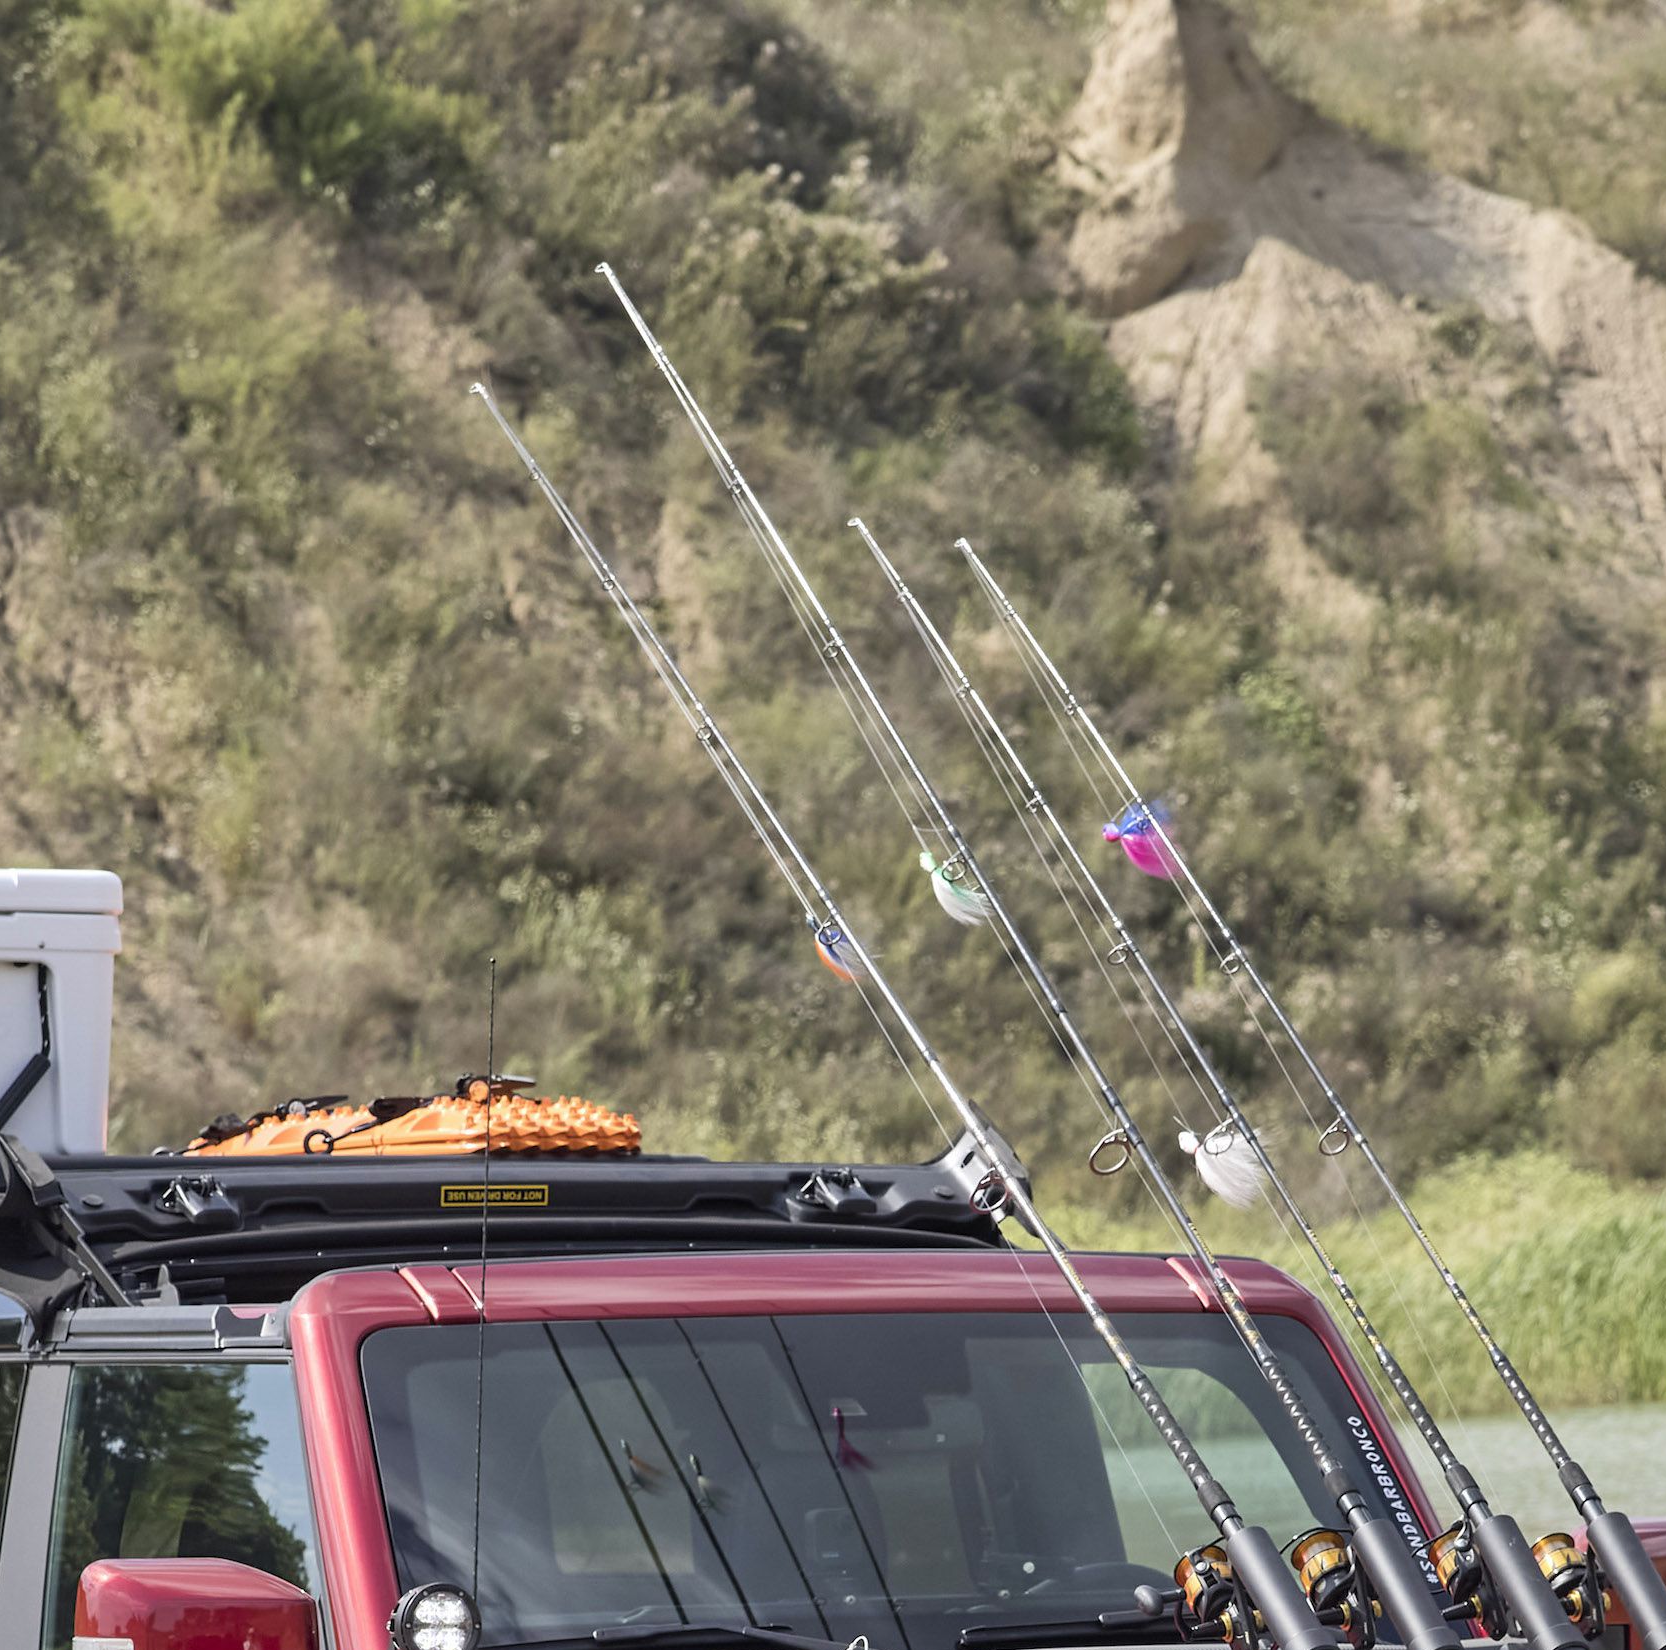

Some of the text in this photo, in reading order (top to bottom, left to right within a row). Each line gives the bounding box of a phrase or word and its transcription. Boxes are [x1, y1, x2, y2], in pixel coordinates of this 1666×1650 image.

[447, 1190, 543, 1202] NOT FOR DRVEN USE
[1346, 1415, 1439, 1584] #SANDBARBRONCO
